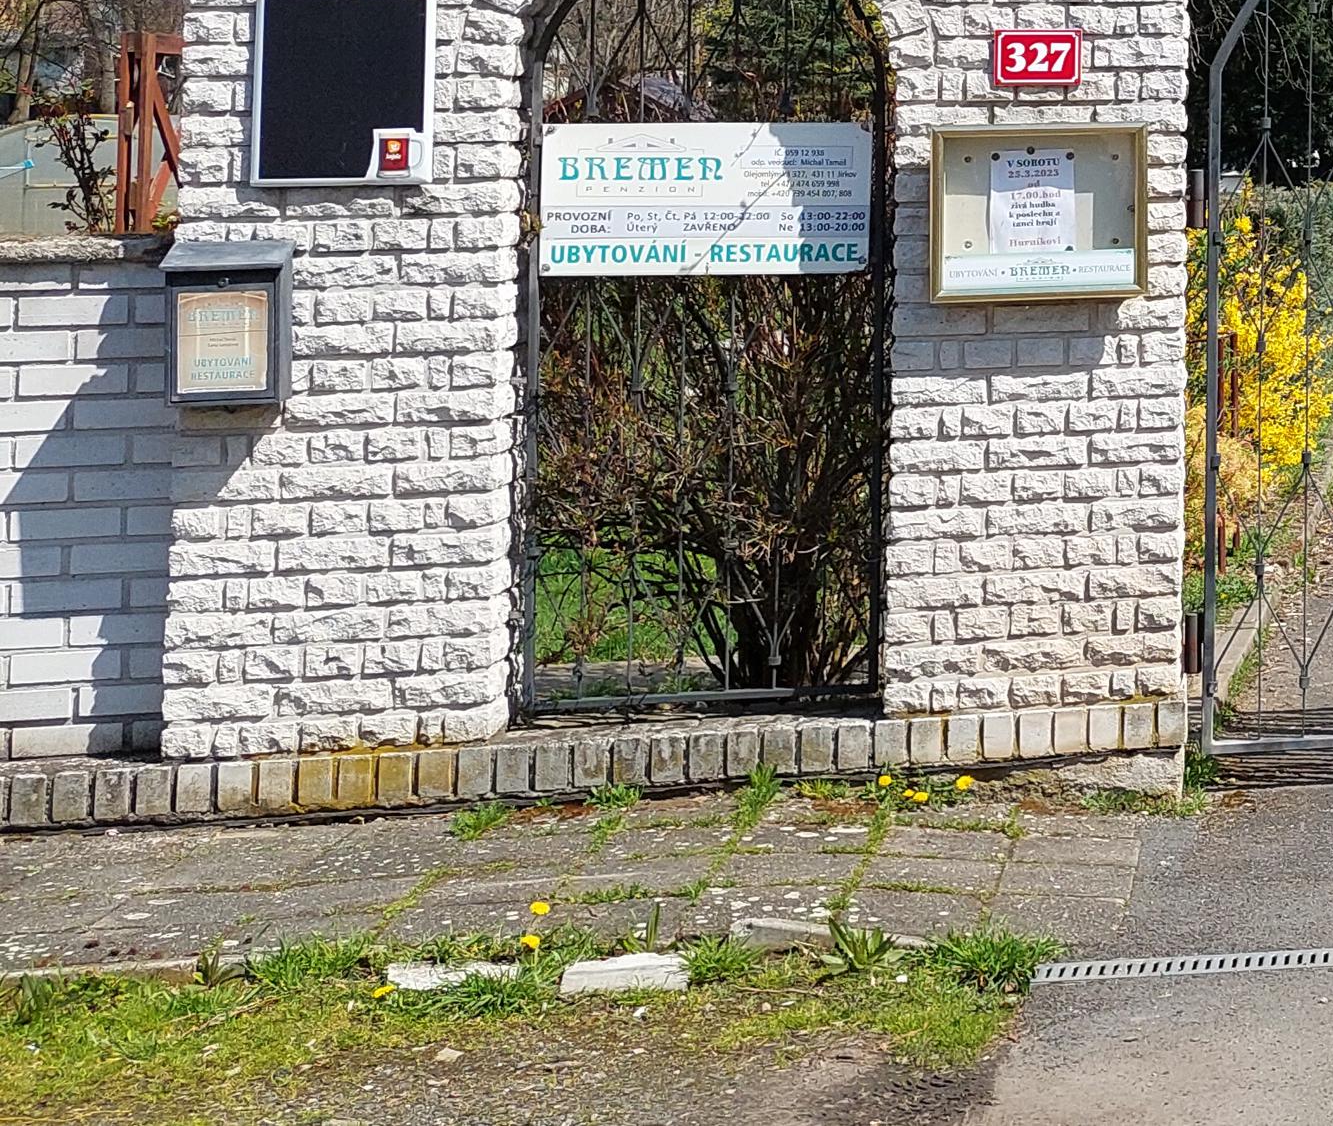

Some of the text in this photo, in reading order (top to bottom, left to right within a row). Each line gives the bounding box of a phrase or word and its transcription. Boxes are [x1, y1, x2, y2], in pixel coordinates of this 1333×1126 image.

[1005, 42, 1071, 72] 327
[785, 149, 799, 157] 059
[800, 158, 823, 166] Michal
[1007, 158, 1060, 168] V SOBOTU
[558, 157, 724, 180] BREMEN
[812, 170, 824, 178] 431
[1027, 180, 1040, 188] od
[806, 190, 820, 198] 454
[1029, 200, 1056, 208] hudba
[546, 210, 612, 222] PROVOZNÍ
[626, 212, 644, 223] Po,
[646, 212, 662, 223] St,
[683, 212, 697, 221] Pá
[703, 211, 770, 220] 12:00-22:00
[781, 211, 794, 220] So
[801, 211, 866, 220] 13:00-22:00
[1016, 210, 1053, 219] poslechu
[570, 221, 865, 234] DOBA: Úterý ZAVŘENO Ne 13:00-20:00
[550, 239, 687, 264] UBYTOVÁNÍ
[709, 243, 858, 263] RESTAURACE
[949, 264, 1131, 278] UBYTOVÁNÍ BREMEN RESTAURACE
[191, 370, 255, 381] RESTAURACE
